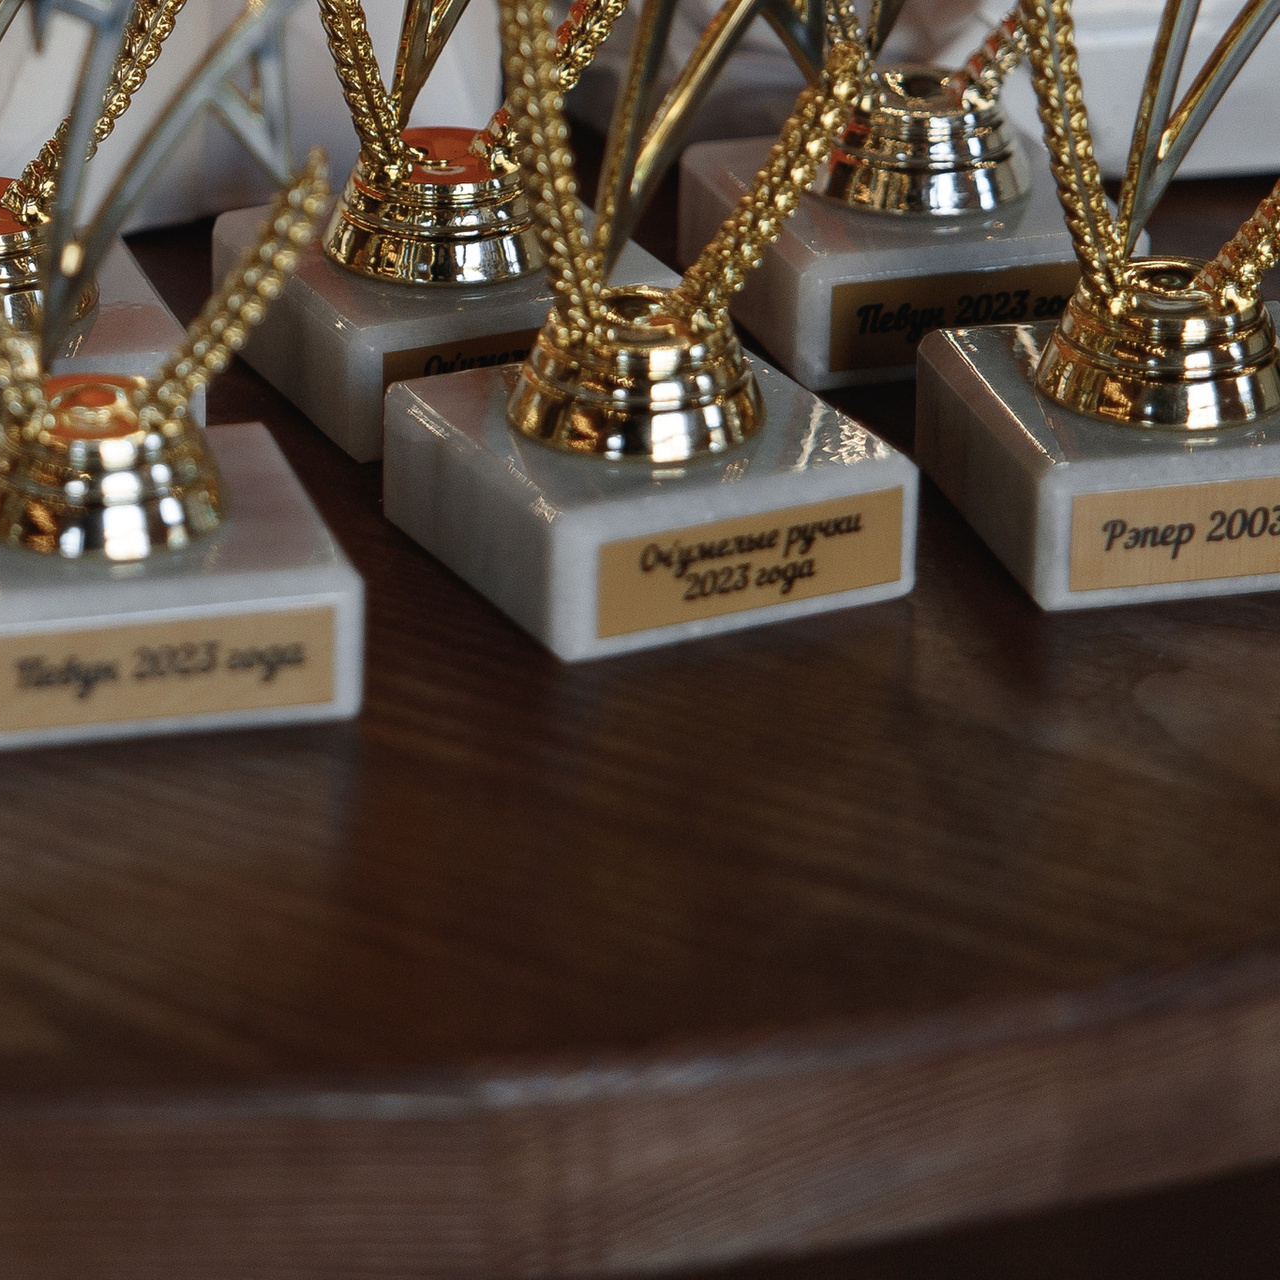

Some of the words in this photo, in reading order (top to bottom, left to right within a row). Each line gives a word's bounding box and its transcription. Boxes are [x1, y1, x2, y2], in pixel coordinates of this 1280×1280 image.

[954, 288, 1030, 323] 2023
[1033, 294, 1069, 318] го
[782, 513, 863, 558] ручки
[1101, 518, 1196, 560] Рэпер
[683, 562, 751, 602] 2023
[755, 558, 817, 596] года
